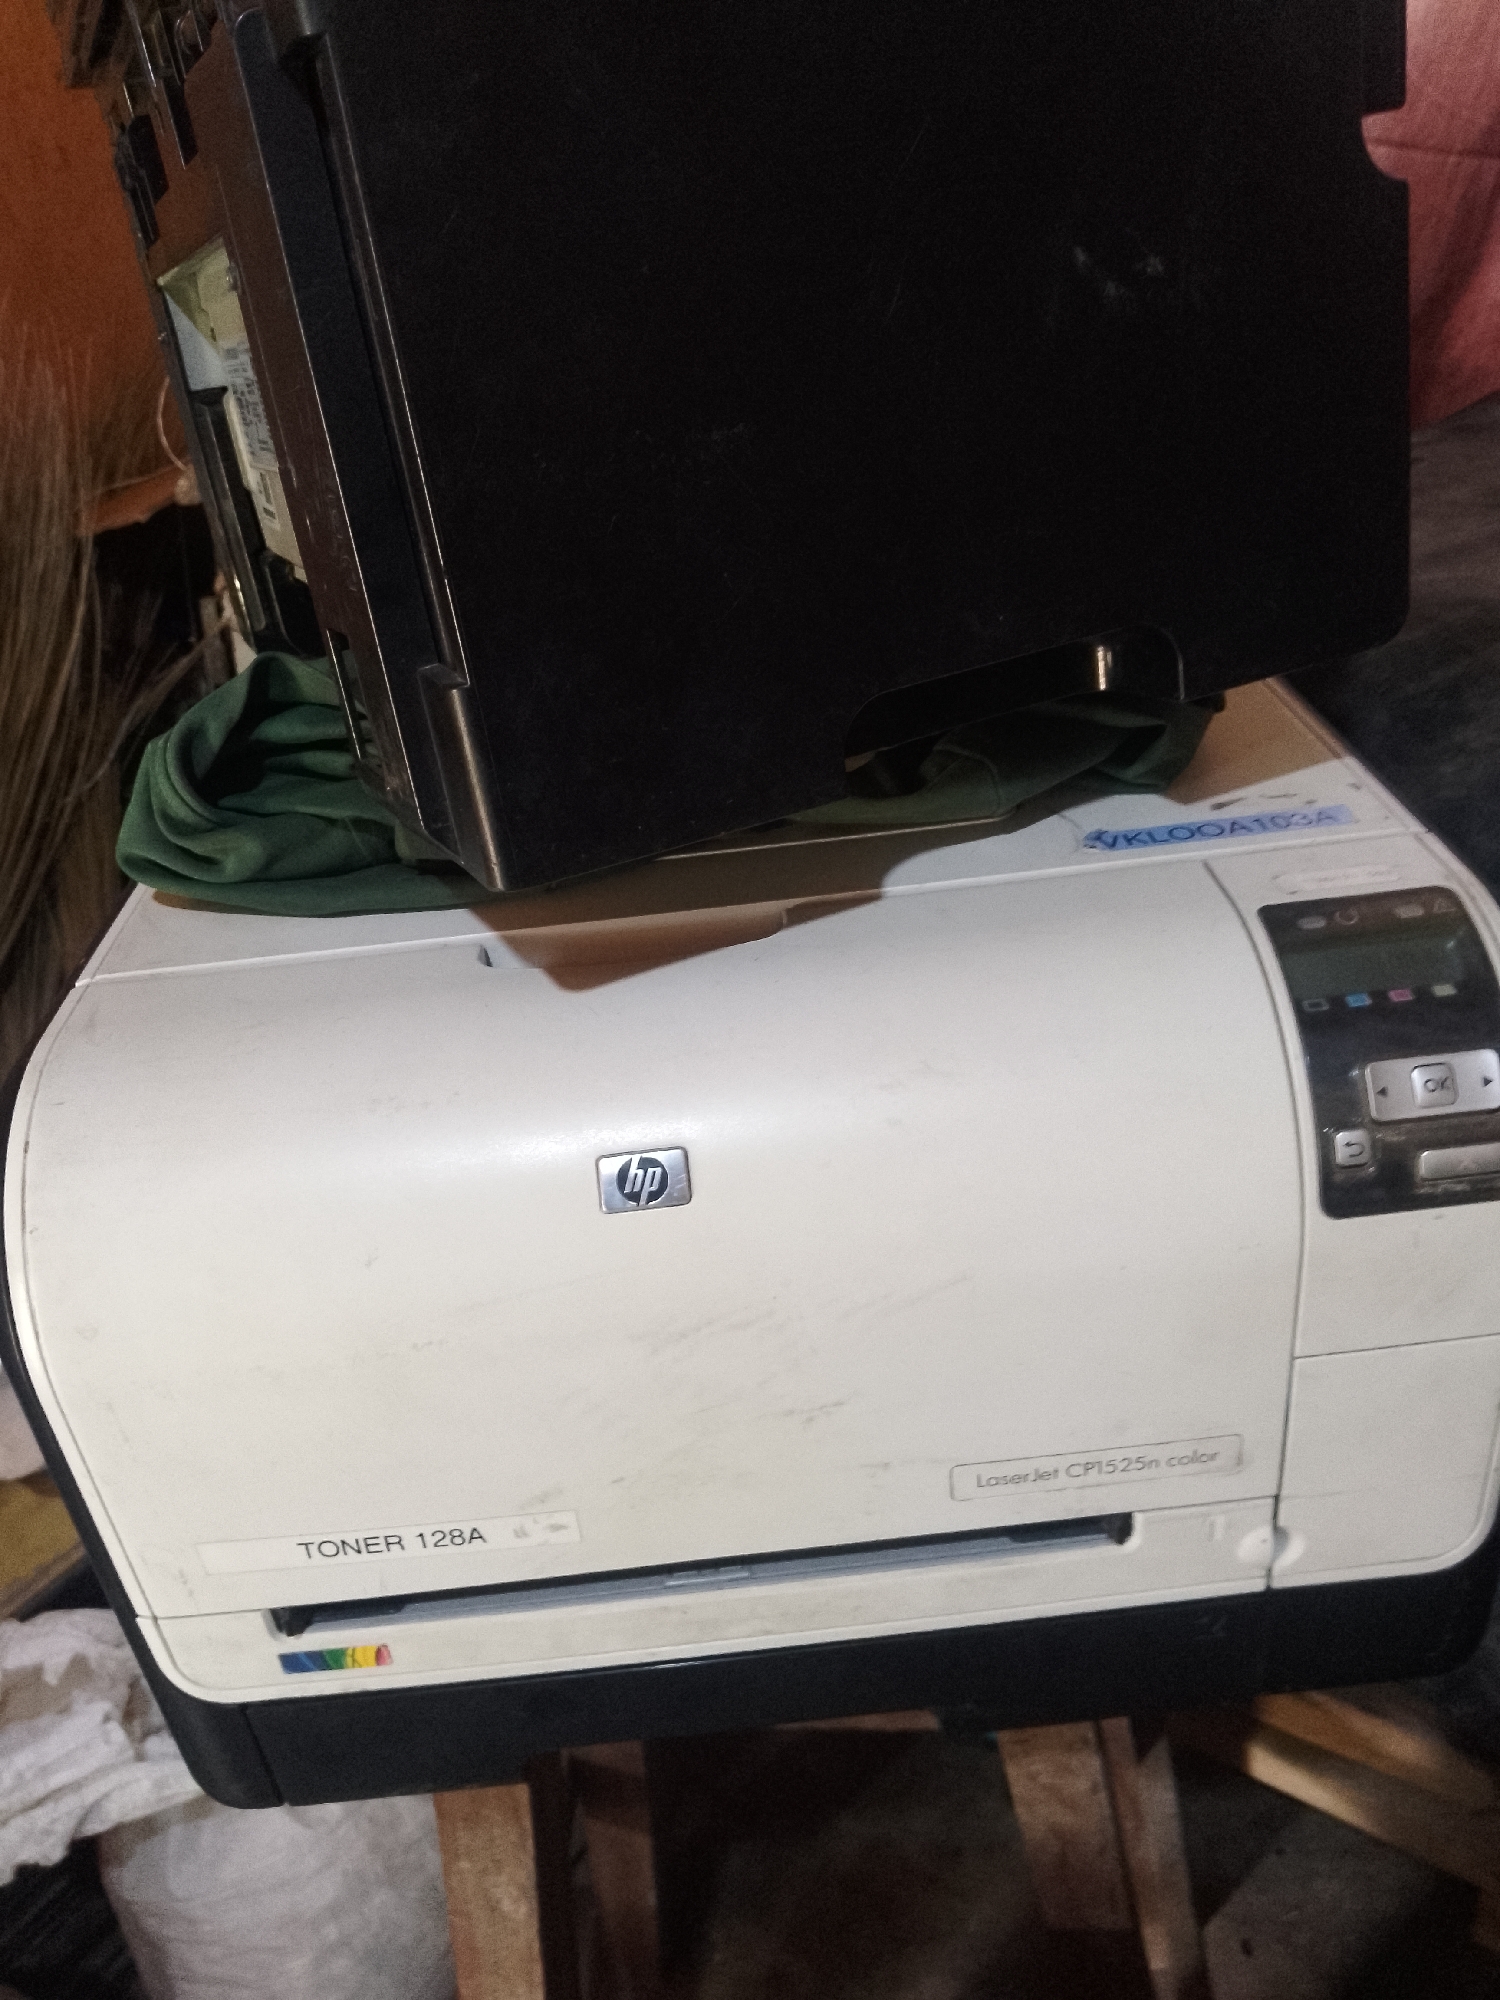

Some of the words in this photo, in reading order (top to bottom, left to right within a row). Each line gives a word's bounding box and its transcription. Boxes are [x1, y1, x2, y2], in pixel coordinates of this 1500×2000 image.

[1424, 1076, 1450, 1092] OK
[621, 1156, 665, 1206] hp
[976, 1467, 1059, 1488] LaserJet
[1065, 1455, 1160, 1478] CP1525n
[1165, 1449, 1219, 1468] color
[297, 1535, 405, 1559] TONER
[416, 1527, 487, 1548] 128A
